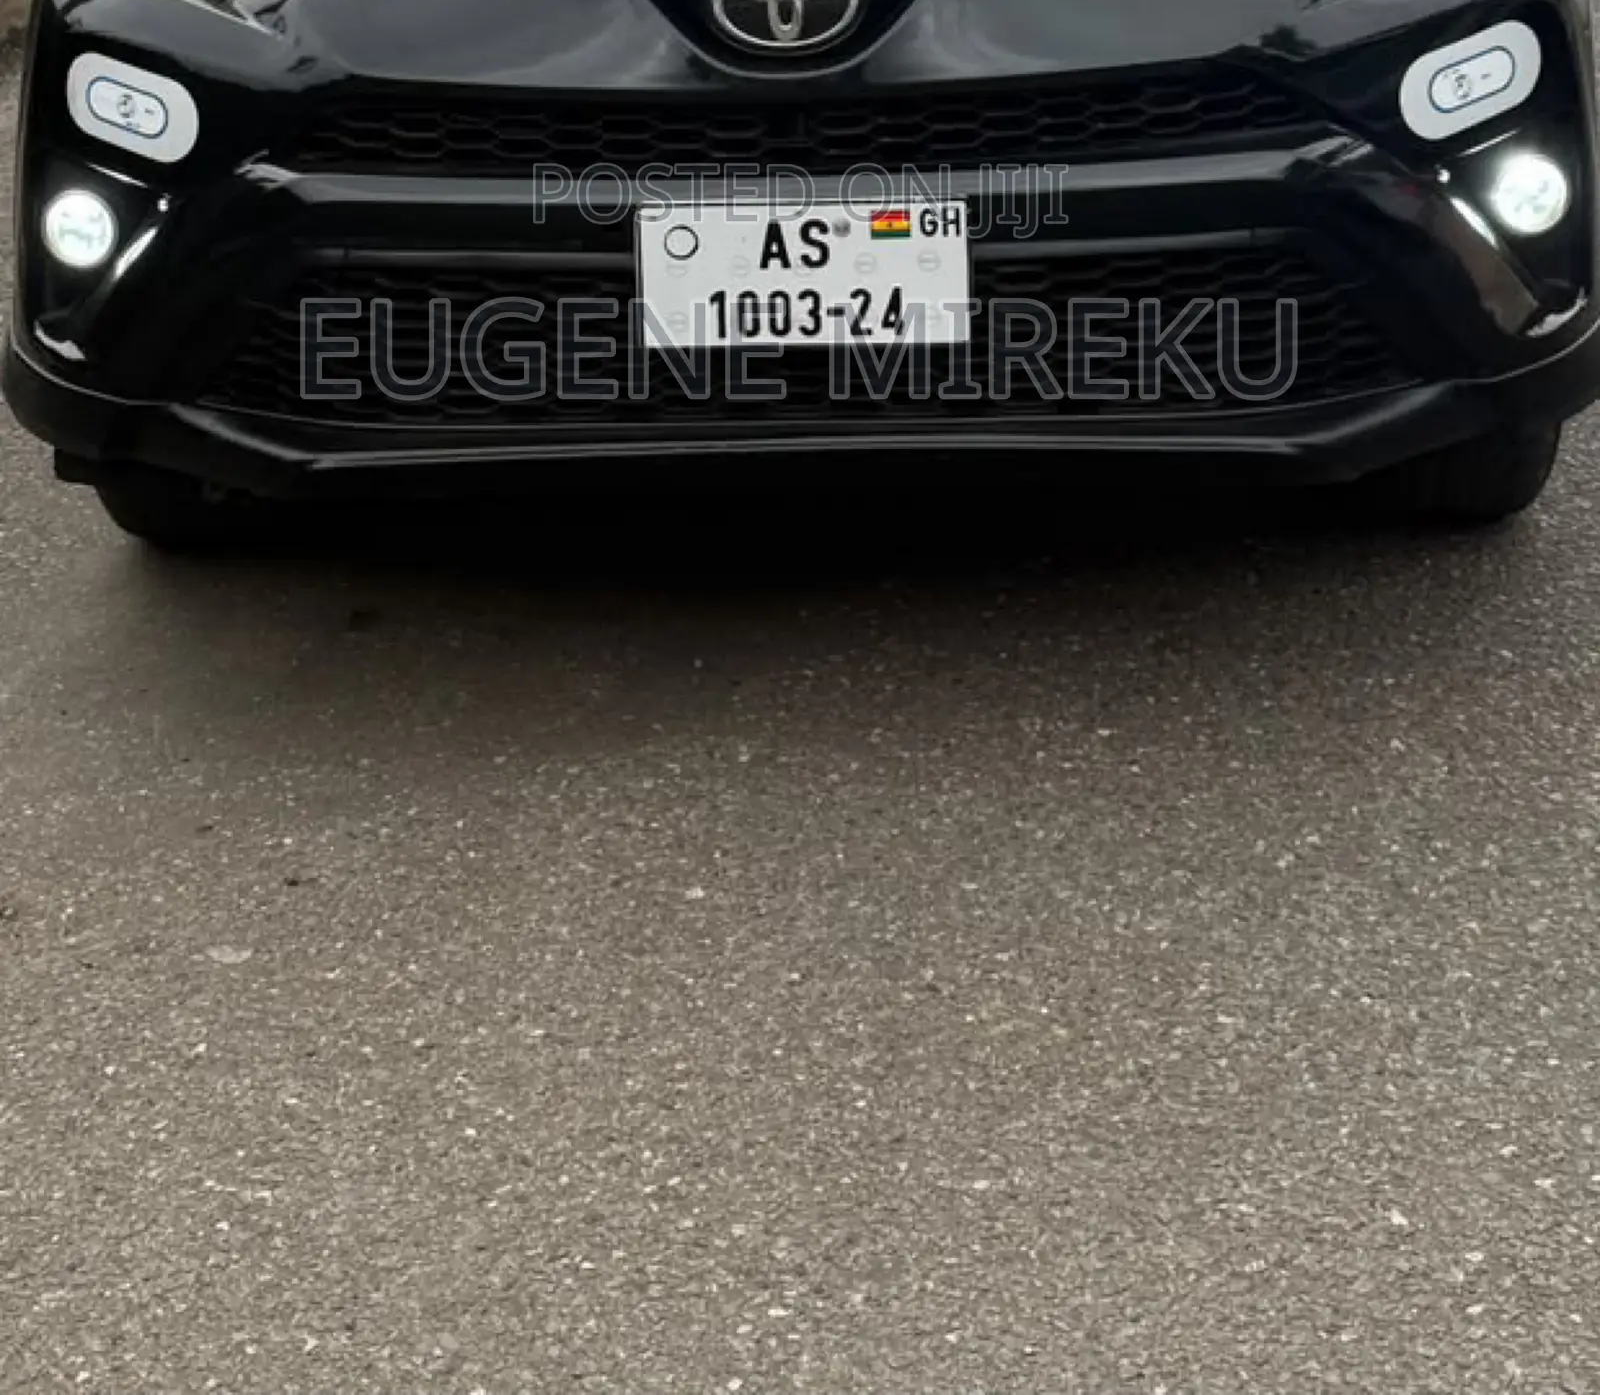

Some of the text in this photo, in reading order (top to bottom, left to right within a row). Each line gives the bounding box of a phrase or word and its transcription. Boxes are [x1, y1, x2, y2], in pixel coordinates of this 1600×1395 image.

[759, 218, 831, 270] AS
[919, 207, 961, 238] GH
[709, 286, 905, 338] 1003-24
